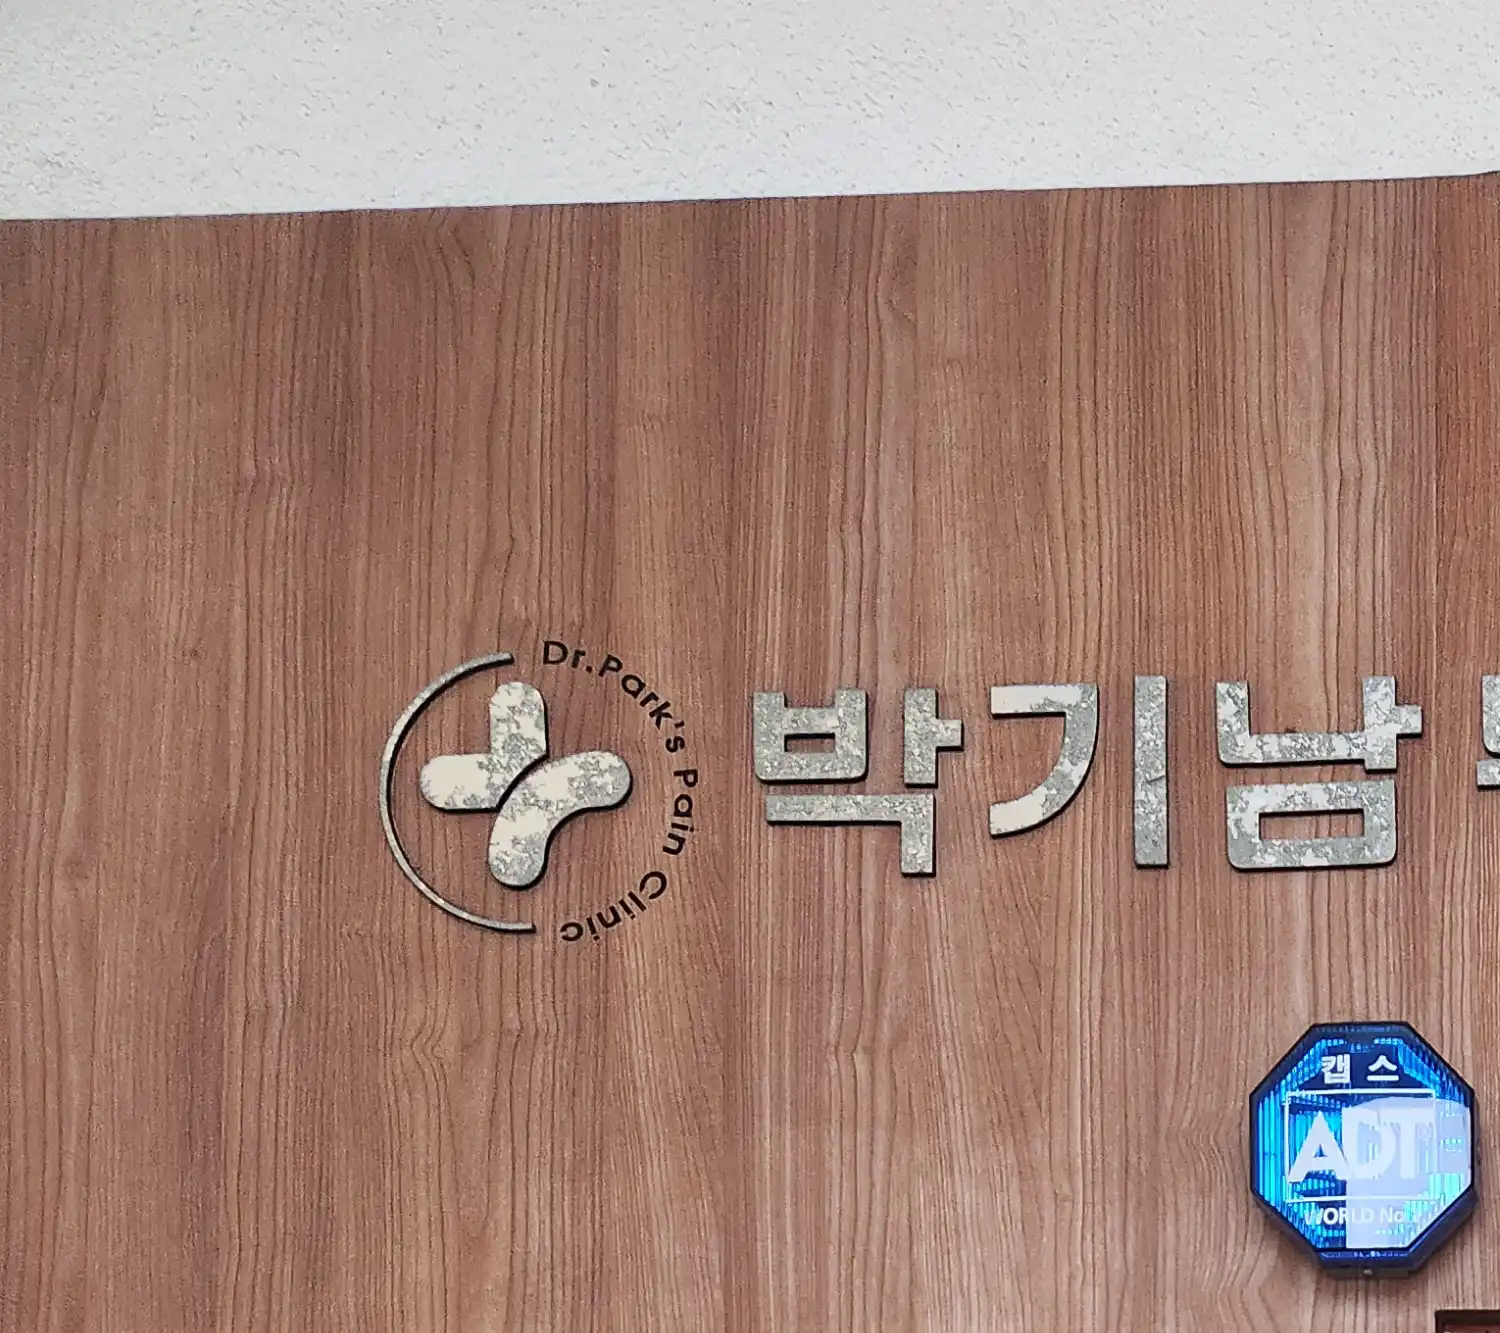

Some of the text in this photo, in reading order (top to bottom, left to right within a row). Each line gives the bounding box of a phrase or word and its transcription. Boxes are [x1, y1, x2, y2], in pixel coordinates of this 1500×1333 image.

[541, 639, 700, 944] Dr.Park's Pain Clinic
[1286, 1107, 1435, 1182] ADT
